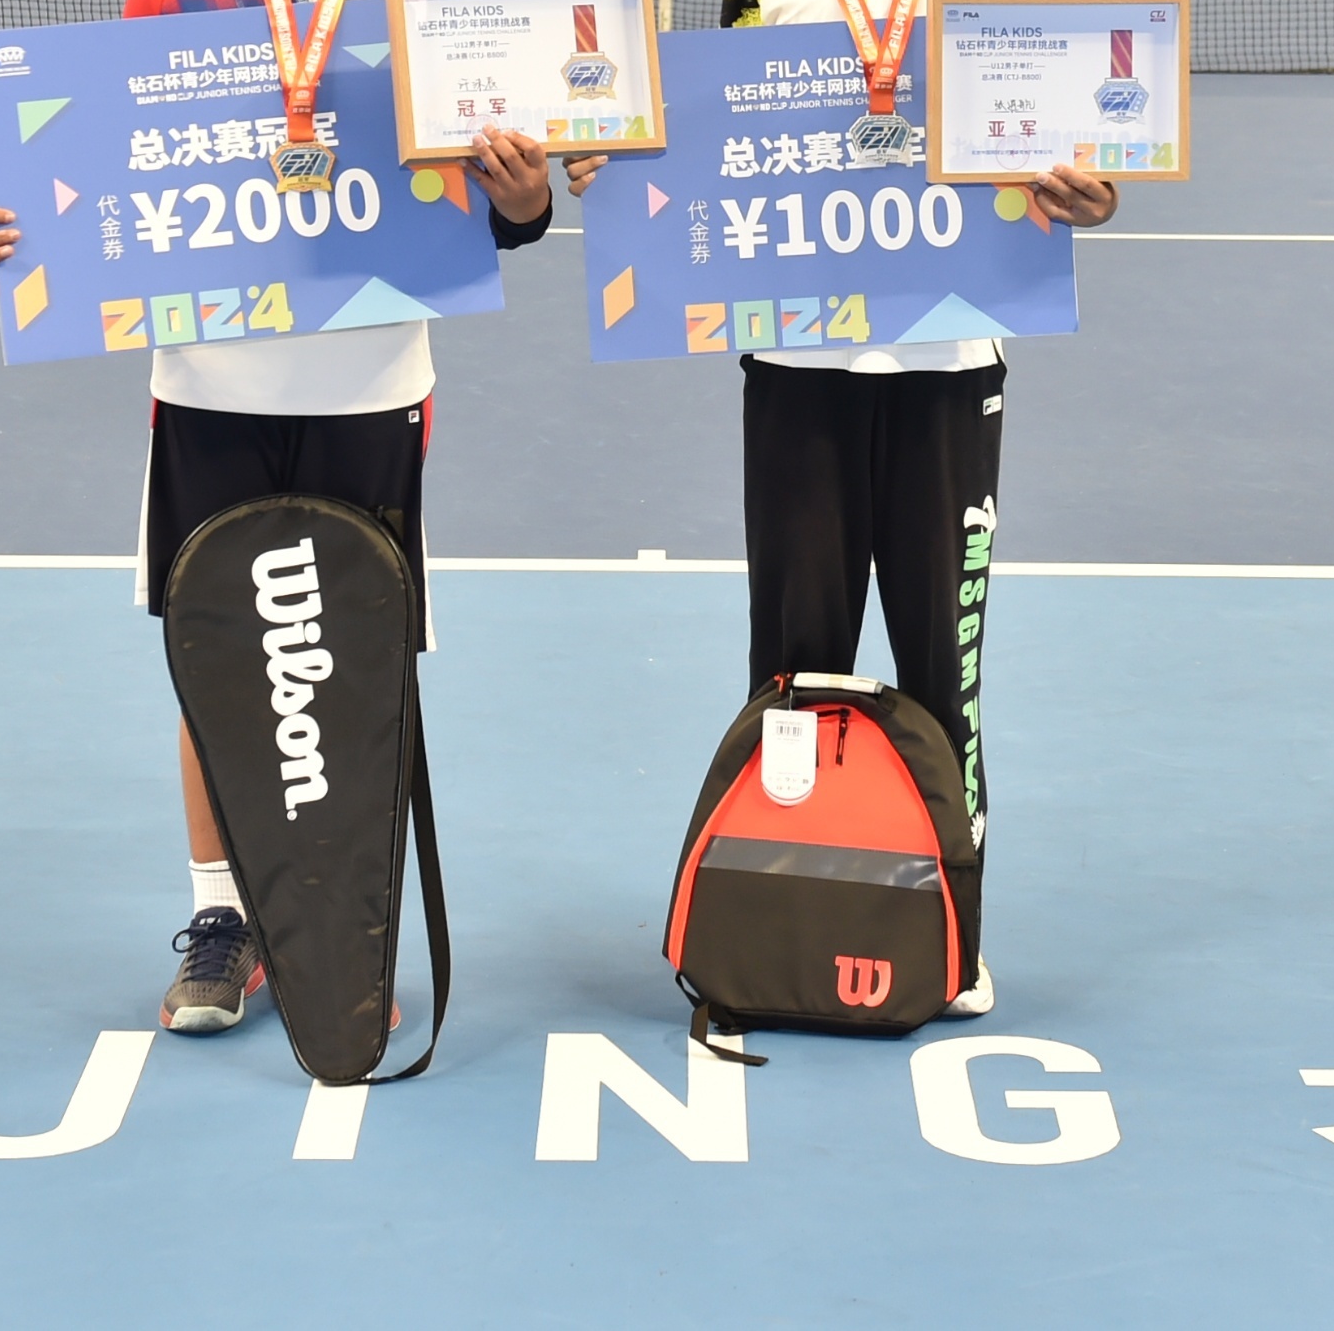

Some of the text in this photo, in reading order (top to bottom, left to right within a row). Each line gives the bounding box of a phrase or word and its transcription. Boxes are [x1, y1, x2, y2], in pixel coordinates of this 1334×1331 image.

[442, 5, 504, 17] FILA KIDS
[981, 27, 1042, 38] FILA KIDS
[169, 42, 274, 69] FILA KIDS
[765, 56, 864, 79] FILA KIDS
[195, 88, 228, 100] JUNIOR
[229, 85, 262, 97] TENNIS
[788, 100, 821, 110] JUNIOR
[822, 98, 854, 108] TENNIS
[1074, 143, 1173, 169] 2024
[96, 194, 125, 261] 代金券
[130, 167, 380, 254] ¥2000
[687, 200, 711, 264] 代金券
[720, 184, 962, 259] ¥1000
[100, 282, 294, 352] 2024
[685, 294, 870, 354] 2024
[251, 537, 334, 811] Wilson
